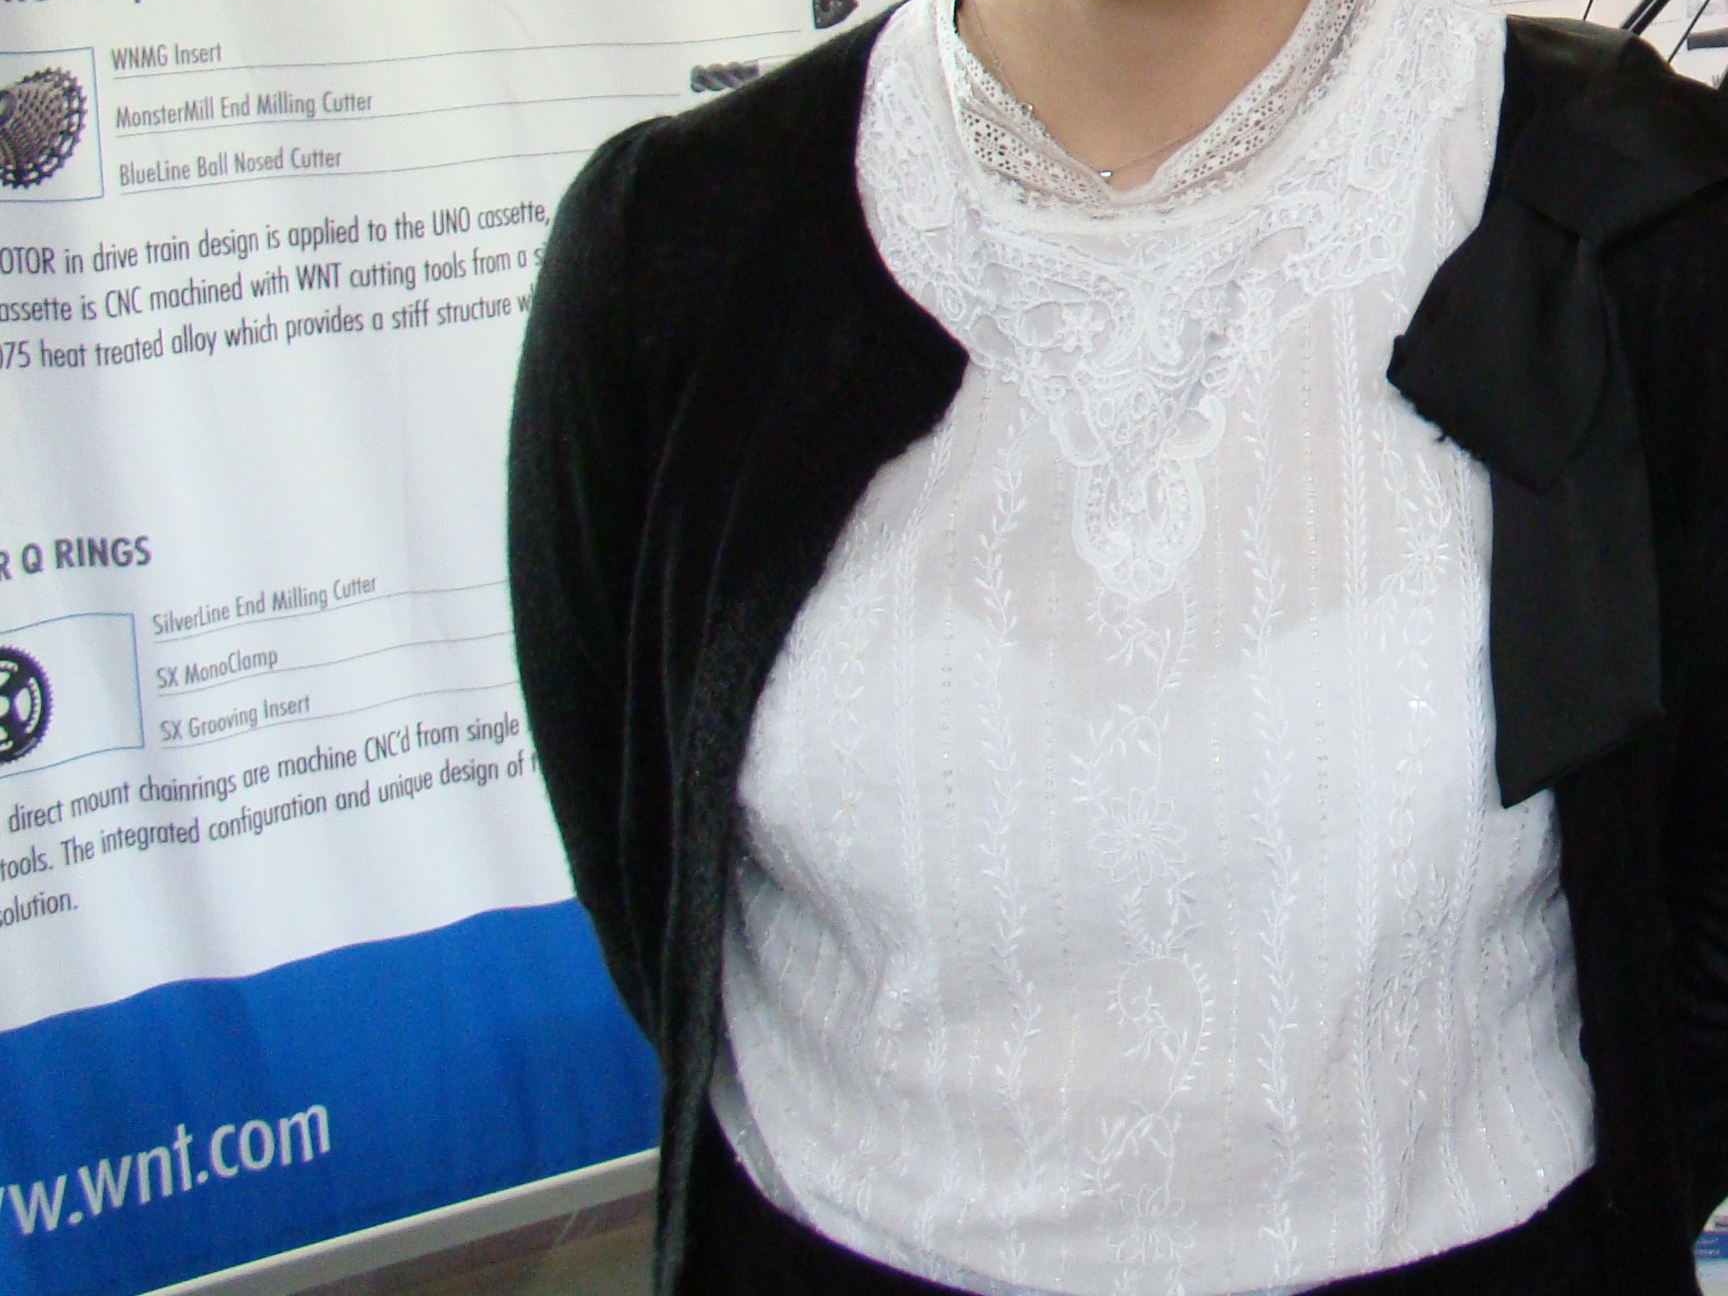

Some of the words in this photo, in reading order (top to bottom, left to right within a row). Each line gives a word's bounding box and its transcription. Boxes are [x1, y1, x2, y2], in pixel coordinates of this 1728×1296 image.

[112, 46, 168, 70] WNMG
[175, 43, 223, 66] Insert
[116, 97, 215, 129] MonsterMill
[222, 94, 250, 119] End
[257, 93, 316, 118] Milling
[322, 91, 373, 114] Cutter
[120, 159, 191, 186] BlueLine
[197, 151, 228, 178] Ball
[235, 147, 284, 172] Nosed
[291, 148, 342, 170] Cutter
[0, 246, 56, 275] OTOR
[65, 248, 84, 274] in
[93, 241, 138, 273] drive
[146, 235, 190, 264] train
[199, 228, 259, 260] design
[265, 224, 281, 249] is
[288, 214, 359, 252] applied
[368, 219, 387, 242] to
[395, 211, 425, 240] the
[432, 206, 470, 236] UNO
[477, 200, 551, 230] cassette,
[0, 296, 72, 323] assette
[80, 295, 97, 321] is
[105, 286, 143, 318] CNC
[150, 270, 243, 311] machined
[250, 265, 289, 299] with
[296, 262, 342, 291] WNT
[350, 260, 416, 291] cutting
[423, 250, 467, 283] tools
[472, 246, 511, 276] from
[517, 249, 527, 268] a
[40, 338, 86, 368] heat
[95, 327, 164, 367] treated
[172, 322, 217, 357] alloy
[224, 313, 279, 347] which
[286, 305, 364, 346] provides
[372, 311, 384, 330] a
[392, 298, 430, 330] stiff
[437, 296, 512, 326] structure
[21, 543, 44, 574] Q
[55, 535, 152, 570] RINGS
[153, 604, 231, 636] SilverLine
[236, 591, 266, 618] End
[272, 586, 329, 612] Milling
[333, 577, 378, 601] Cutter
[157, 667, 180, 690] SX
[185, 648, 279, 685] MonoClamp
[160, 718, 183, 742] SX
[189, 705, 258, 738] Grooving
[263, 695, 311, 720] Insert
[8, 799, 64, 833] direct
[71, 781, 130, 818] mount
[139, 773, 237, 803] chainrings
[243, 764, 270, 789] are
[278, 745, 357, 780] machine
[416, 721, 460, 749] from
[467, 711, 520, 745] single
[0, 844, 54, 883] tools.
[60, 836, 96, 868] The
[101, 817, 201, 854] integrated
[208, 792, 328, 842] configuration
[335, 779, 371, 812] and
[378, 770, 433, 805] unique
[440, 757, 499, 787] design
[507, 749, 525, 778] of
